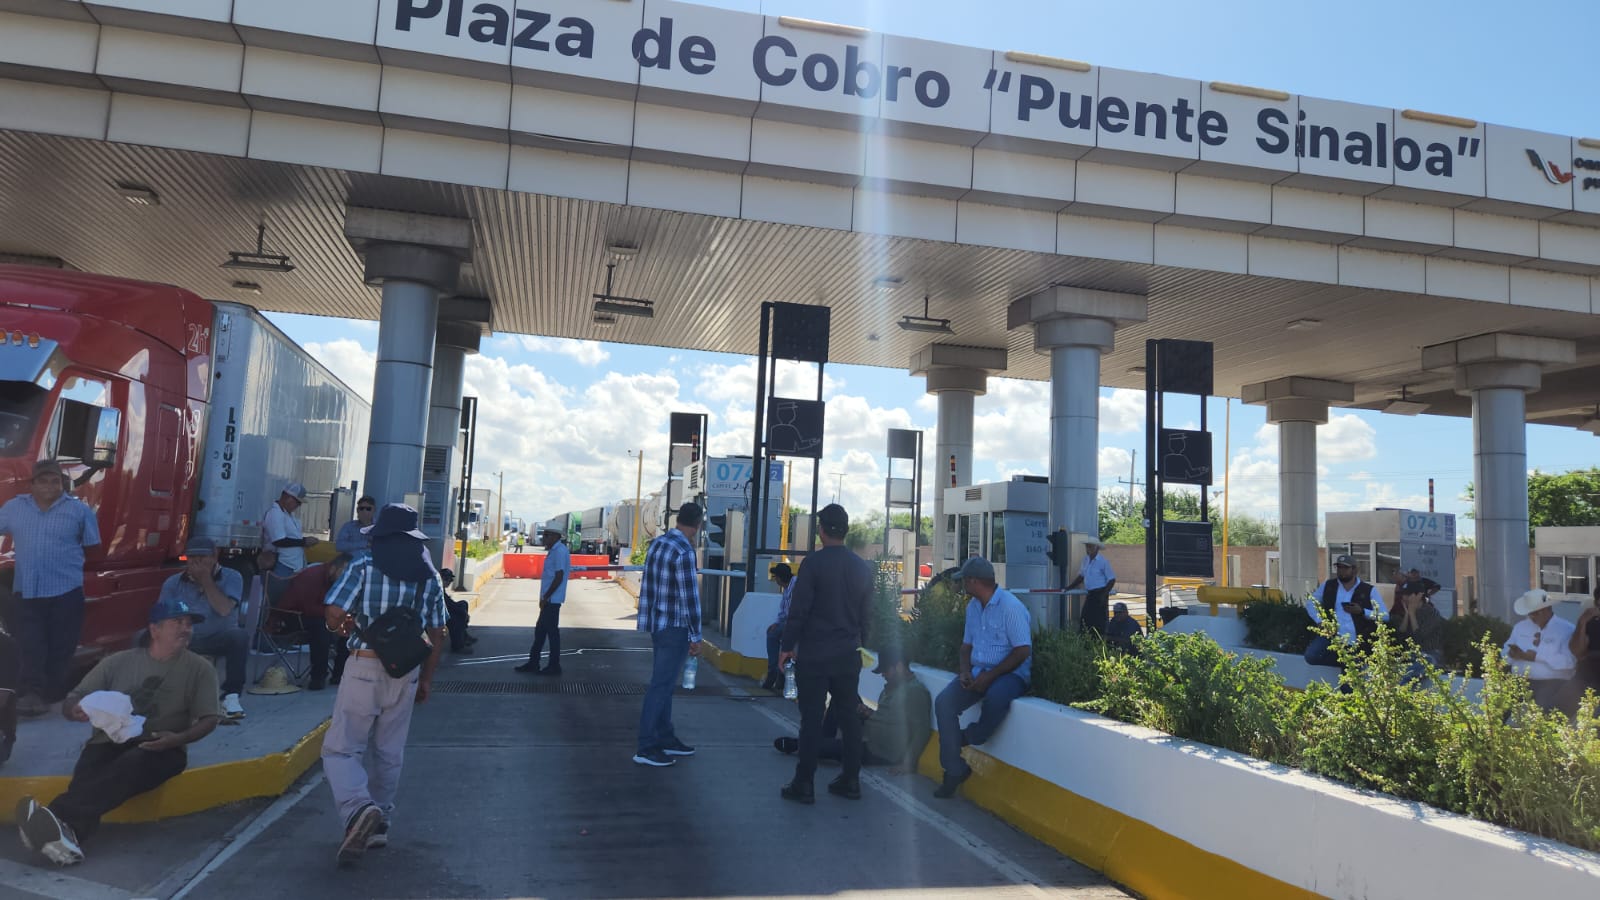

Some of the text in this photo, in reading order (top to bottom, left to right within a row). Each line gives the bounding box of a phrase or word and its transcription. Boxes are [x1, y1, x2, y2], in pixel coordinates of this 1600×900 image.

[631, 18, 717, 75] de
[752, 35, 951, 109] Cobro
[1407, 515, 1438, 531] 074
